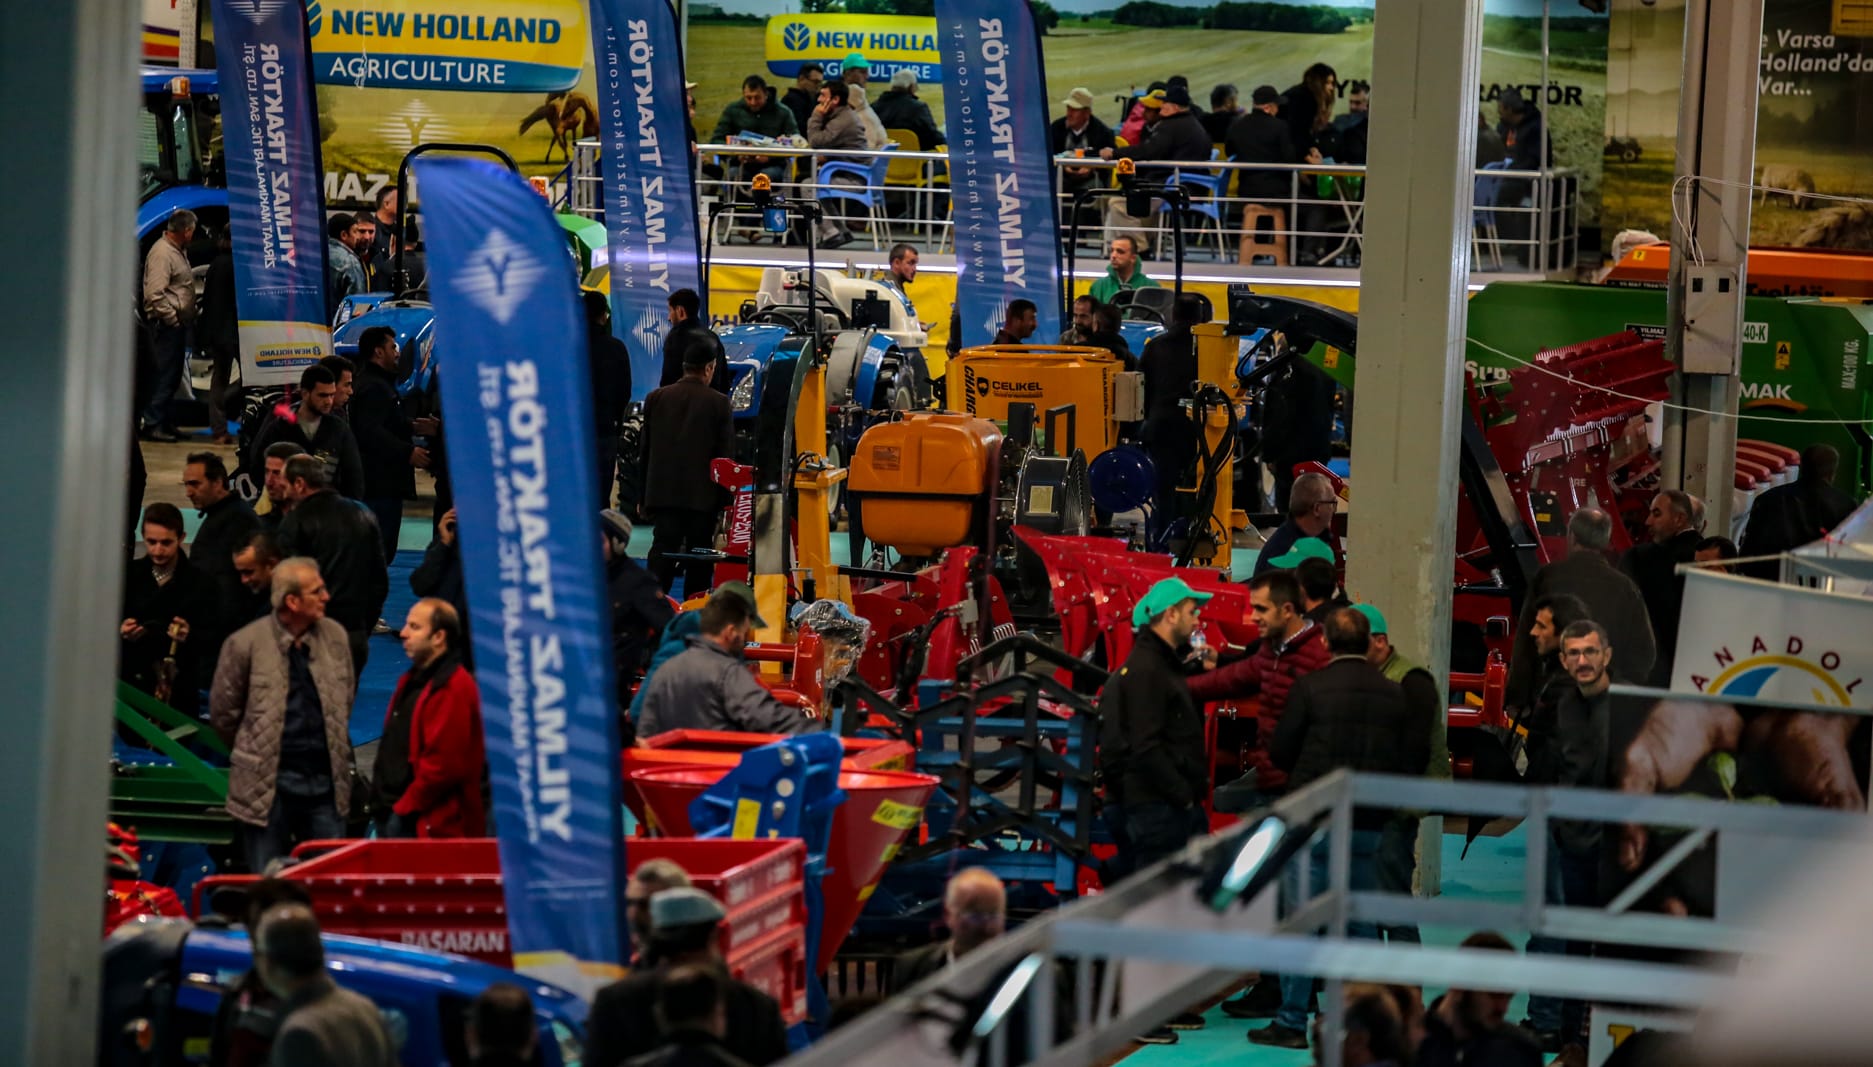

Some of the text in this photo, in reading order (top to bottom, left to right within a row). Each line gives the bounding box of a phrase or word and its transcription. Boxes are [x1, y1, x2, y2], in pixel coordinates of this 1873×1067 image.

[332, 10, 561, 44] NEW HOLLAND
[1777, 28, 1836, 48] Varsa
[816, 31, 864, 48] NEW
[329, 57, 506, 84] AGRICULTURE
[1759, 77, 1812, 95] Var...
[964, 365, 977, 418] CHARG
